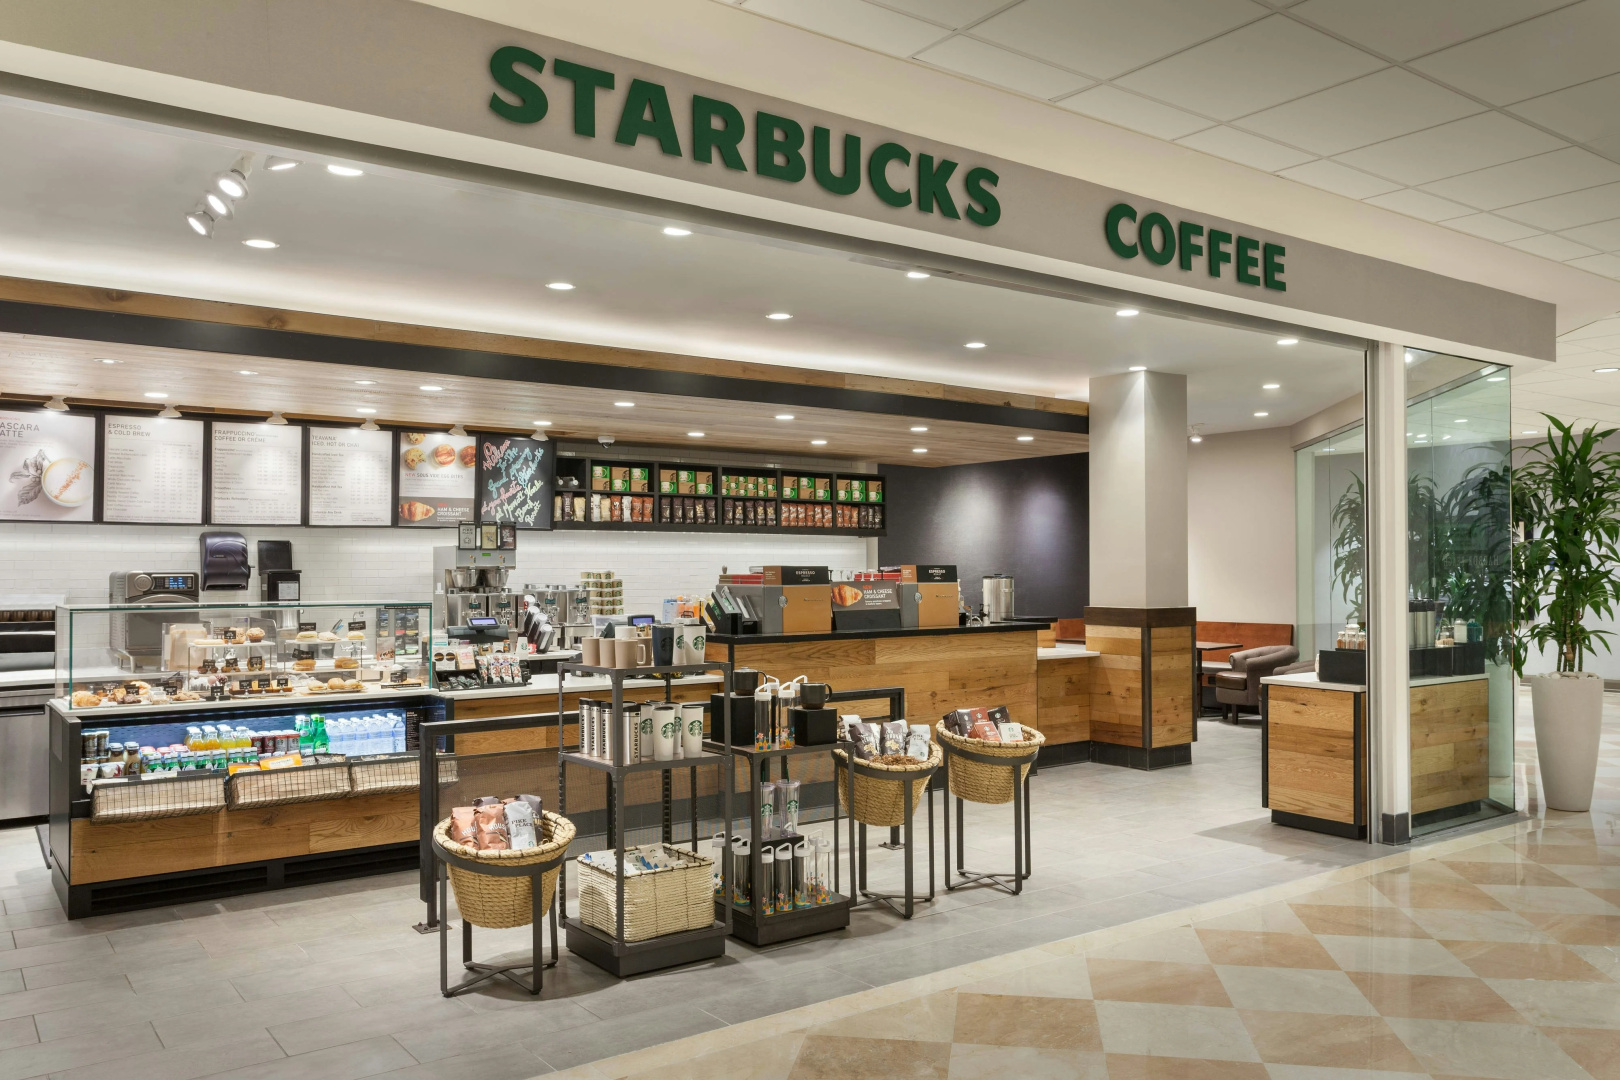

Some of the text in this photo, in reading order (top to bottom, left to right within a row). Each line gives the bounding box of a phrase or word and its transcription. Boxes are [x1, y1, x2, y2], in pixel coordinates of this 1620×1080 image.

[489, 45, 1287, 292] STARBUCKS COFFEE
[518, 448, 544, 488] Starbucks
[514, 499, 536, 522] Beach
[525, 500, 541, 526] Resort
[462, 824, 477, 836] HOU
[488, 823, 506, 831] HOUS
